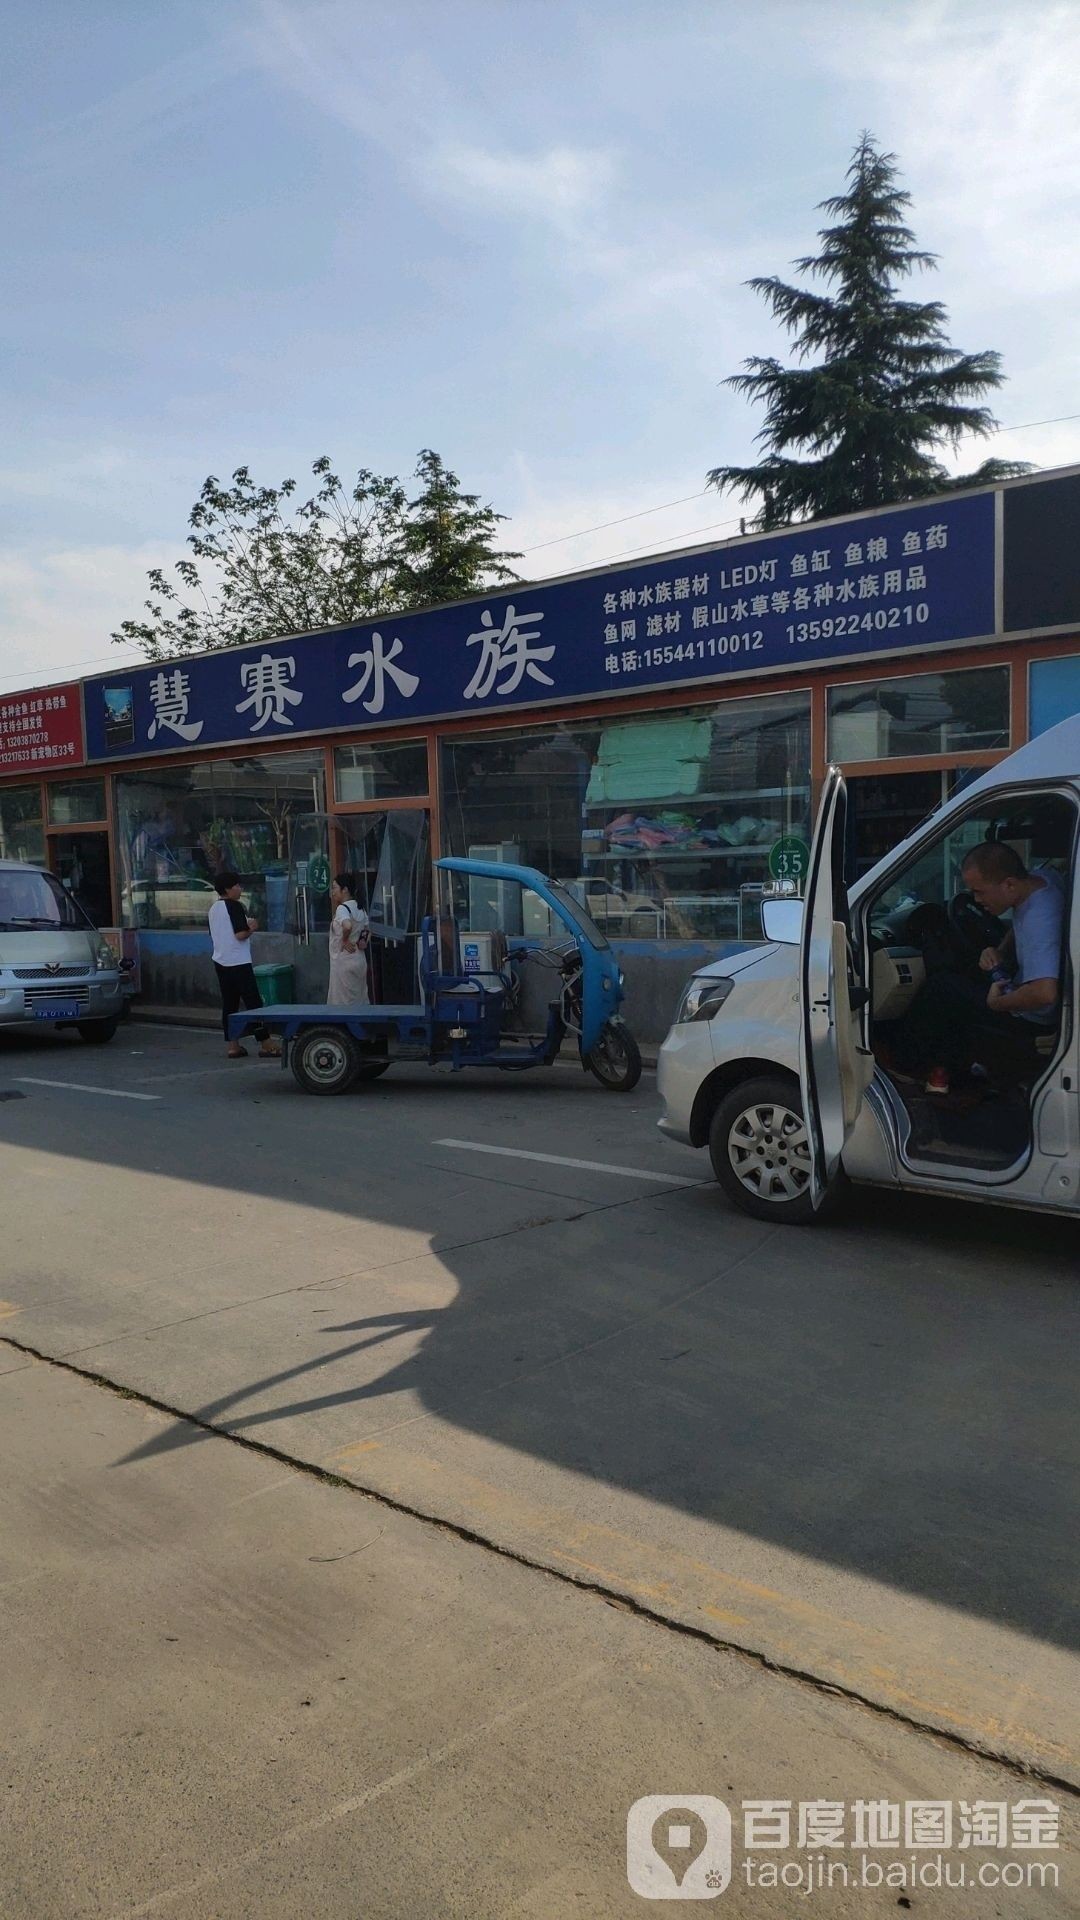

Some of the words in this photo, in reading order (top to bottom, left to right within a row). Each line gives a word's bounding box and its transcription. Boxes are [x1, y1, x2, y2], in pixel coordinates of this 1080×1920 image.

[603, 573, 710, 614] 各种水族器材
[720, 559, 778, 590] LED灯
[790, 549, 831, 578] 鱼缸
[844, 536, 888, 567] 鱼粮
[902, 524, 948, 556] 鱼药
[603, 619, 636, 645] 鱼网
[646, 610, 681, 637] 滤材
[692, 565, 927, 629] 假山水草等各种水族用品
[786, 602, 929, 644] 13592240210
[147, 604, 557, 743] 慧赛水族
[0, 702, 28, 719] 各种金鱼
[0, 715, 43, 734] 支持全国发货
[0, 750, 30, 764] 13217633
[778, 854, 802, 873] 35
